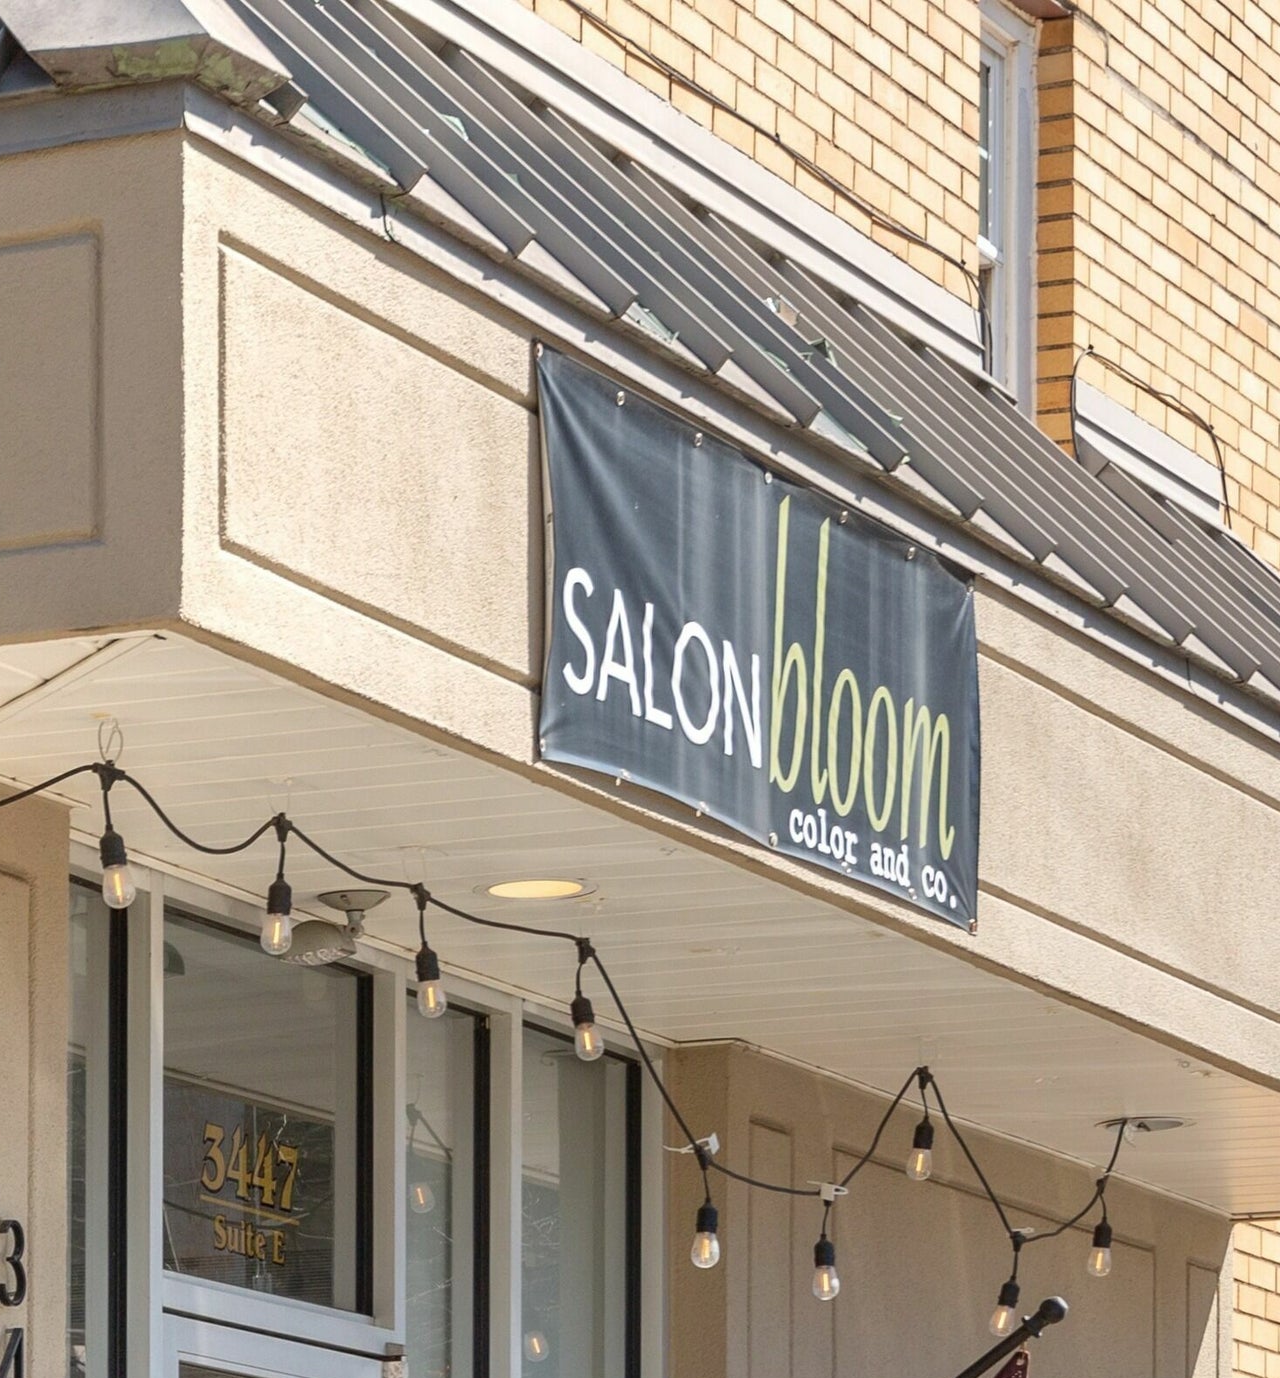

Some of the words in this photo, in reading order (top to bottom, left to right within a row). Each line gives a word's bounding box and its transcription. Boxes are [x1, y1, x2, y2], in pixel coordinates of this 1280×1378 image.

[563, 567, 762, 769] SALON
[769, 495, 956, 861] bloom
[789, 807, 858, 866] color
[869, 840, 911, 890] and
[922, 864, 957, 909] co.
[201, 1121, 298, 1213] 3447
[213, 1214, 267, 1261] Suite
[272, 1229, 286, 1266] E
